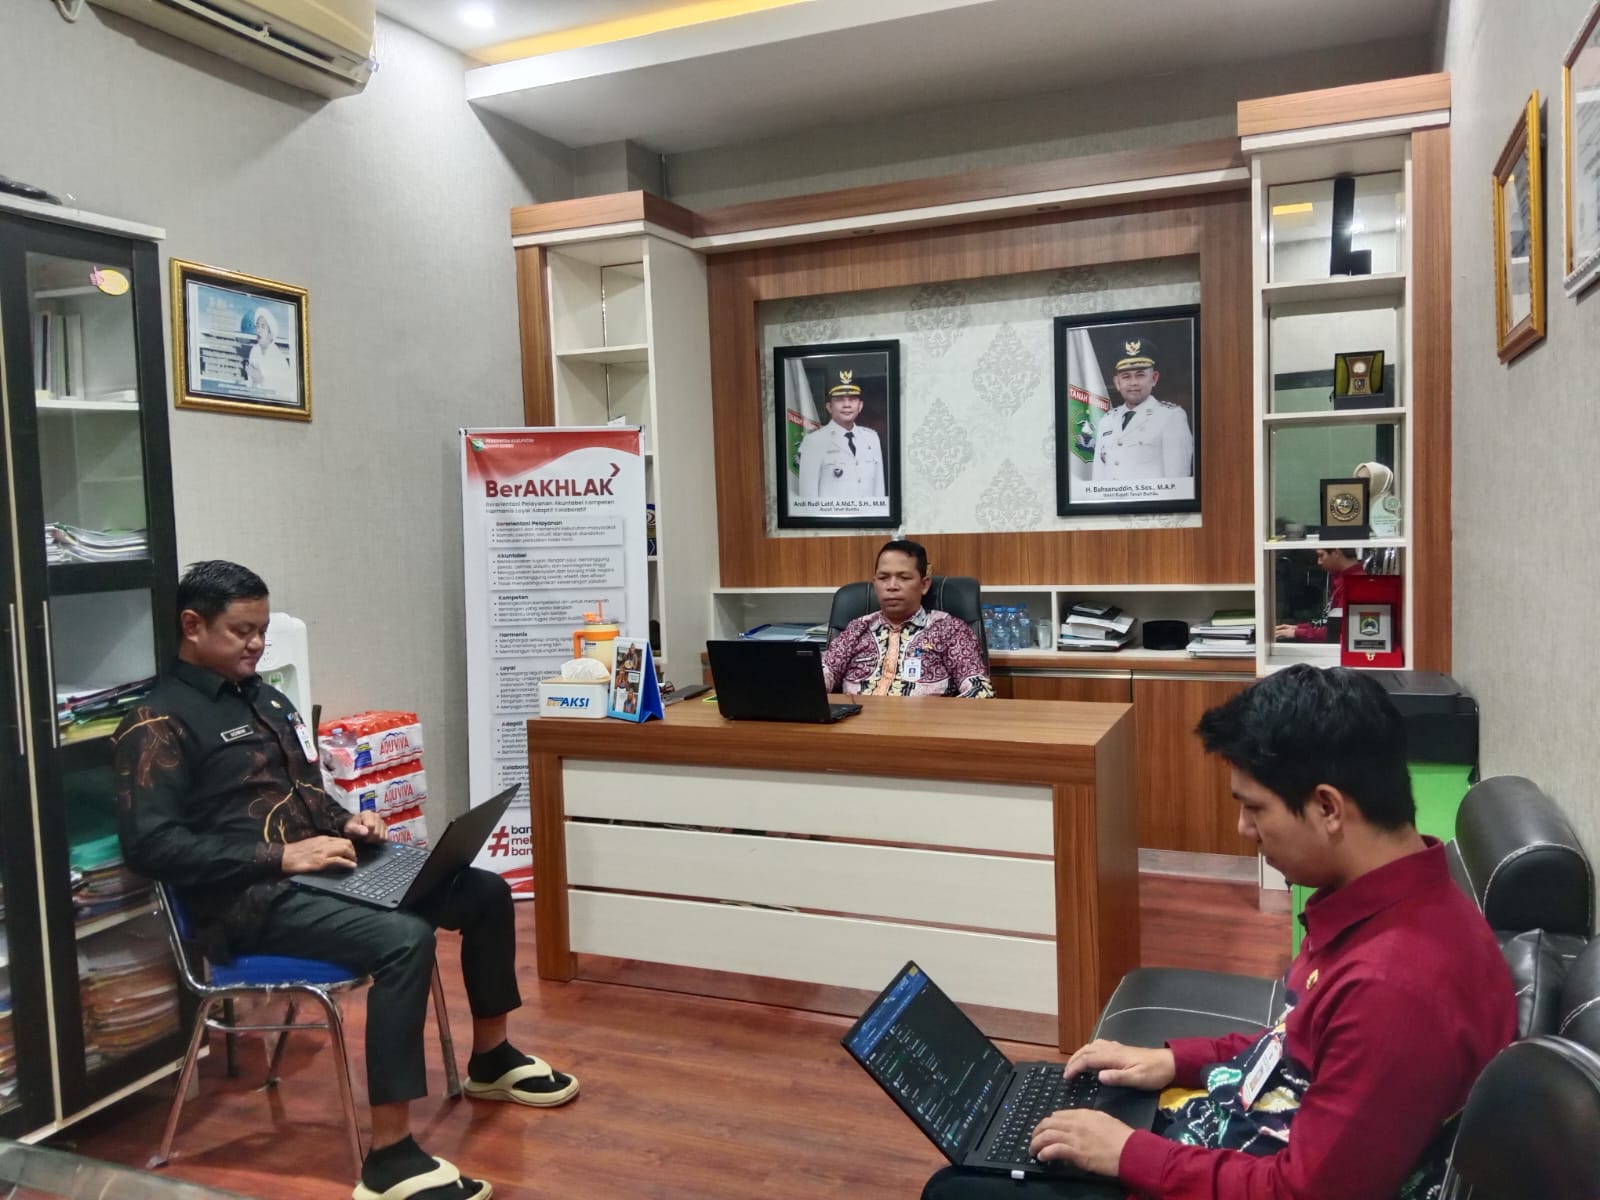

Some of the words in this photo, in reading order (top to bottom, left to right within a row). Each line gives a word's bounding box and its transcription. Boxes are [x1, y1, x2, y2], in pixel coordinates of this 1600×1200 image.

[485, 478, 614, 498] BerAKHLAK
[511, 825, 532, 835] ban
[511, 847, 533, 857] ban
